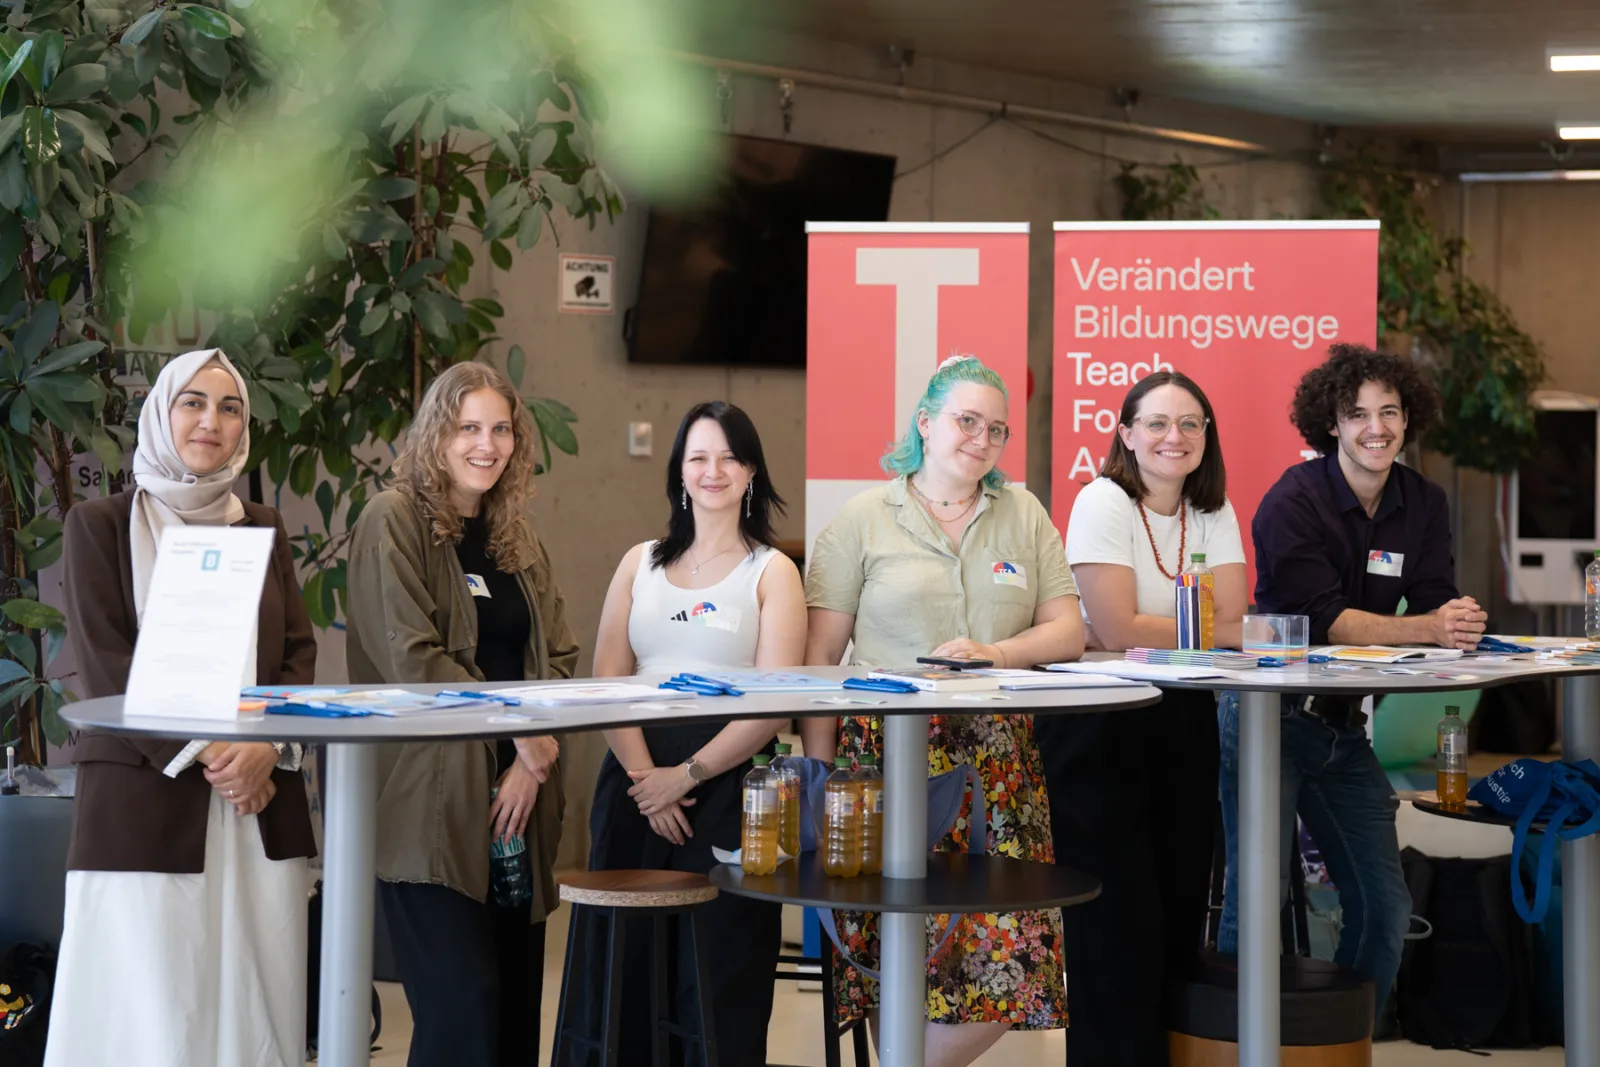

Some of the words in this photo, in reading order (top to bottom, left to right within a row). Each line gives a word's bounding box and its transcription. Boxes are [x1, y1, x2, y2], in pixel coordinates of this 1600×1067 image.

[566, 261, 609, 273] ACHTUNG
[1070, 257, 1255, 291] Verändert
[1074, 304, 1339, 349] Bildungswege
[855, 248, 980, 454] T
[1072, 399, 1120, 433] Fo
